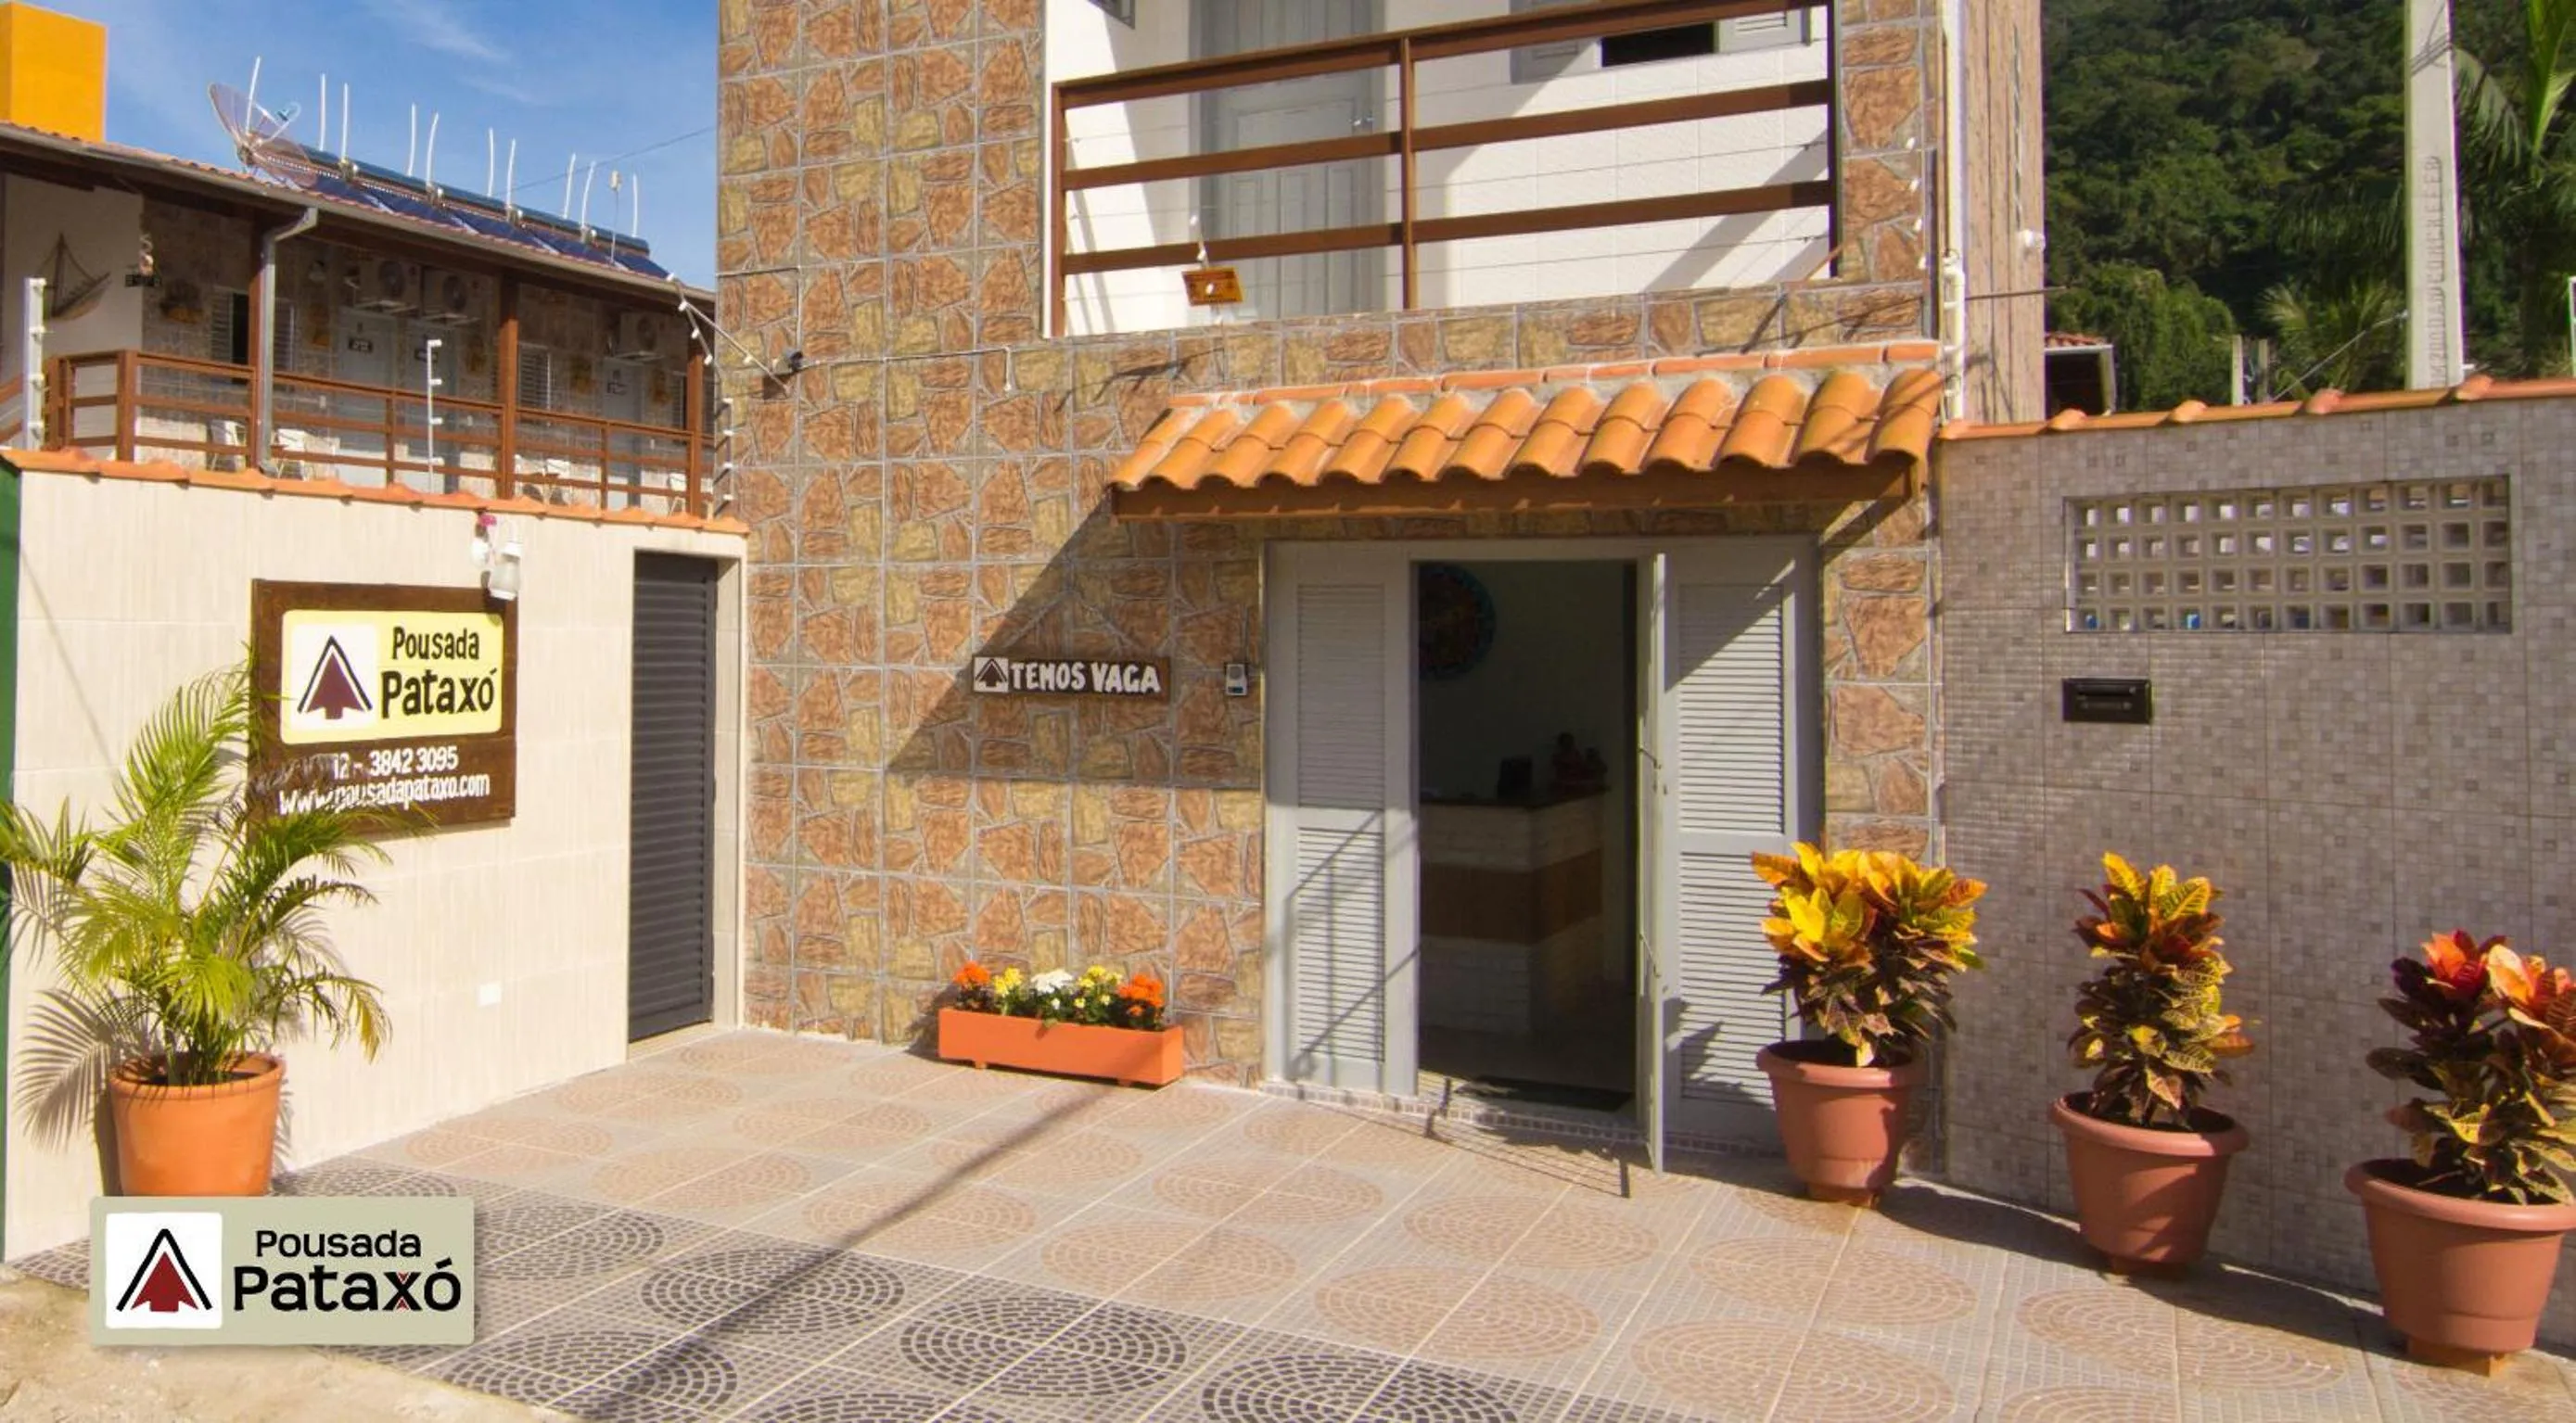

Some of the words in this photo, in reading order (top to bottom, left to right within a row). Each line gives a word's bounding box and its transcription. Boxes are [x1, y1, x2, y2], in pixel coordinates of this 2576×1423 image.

[391, 626, 480, 661] Pousada
[381, 667, 497, 719] Pataxó
[1011, 662, 1086, 691] TEMOS
[1090, 661, 1160, 693] VAGA
[369, 747, 413, 776] 3842
[415, 745, 459, 772] 3095
